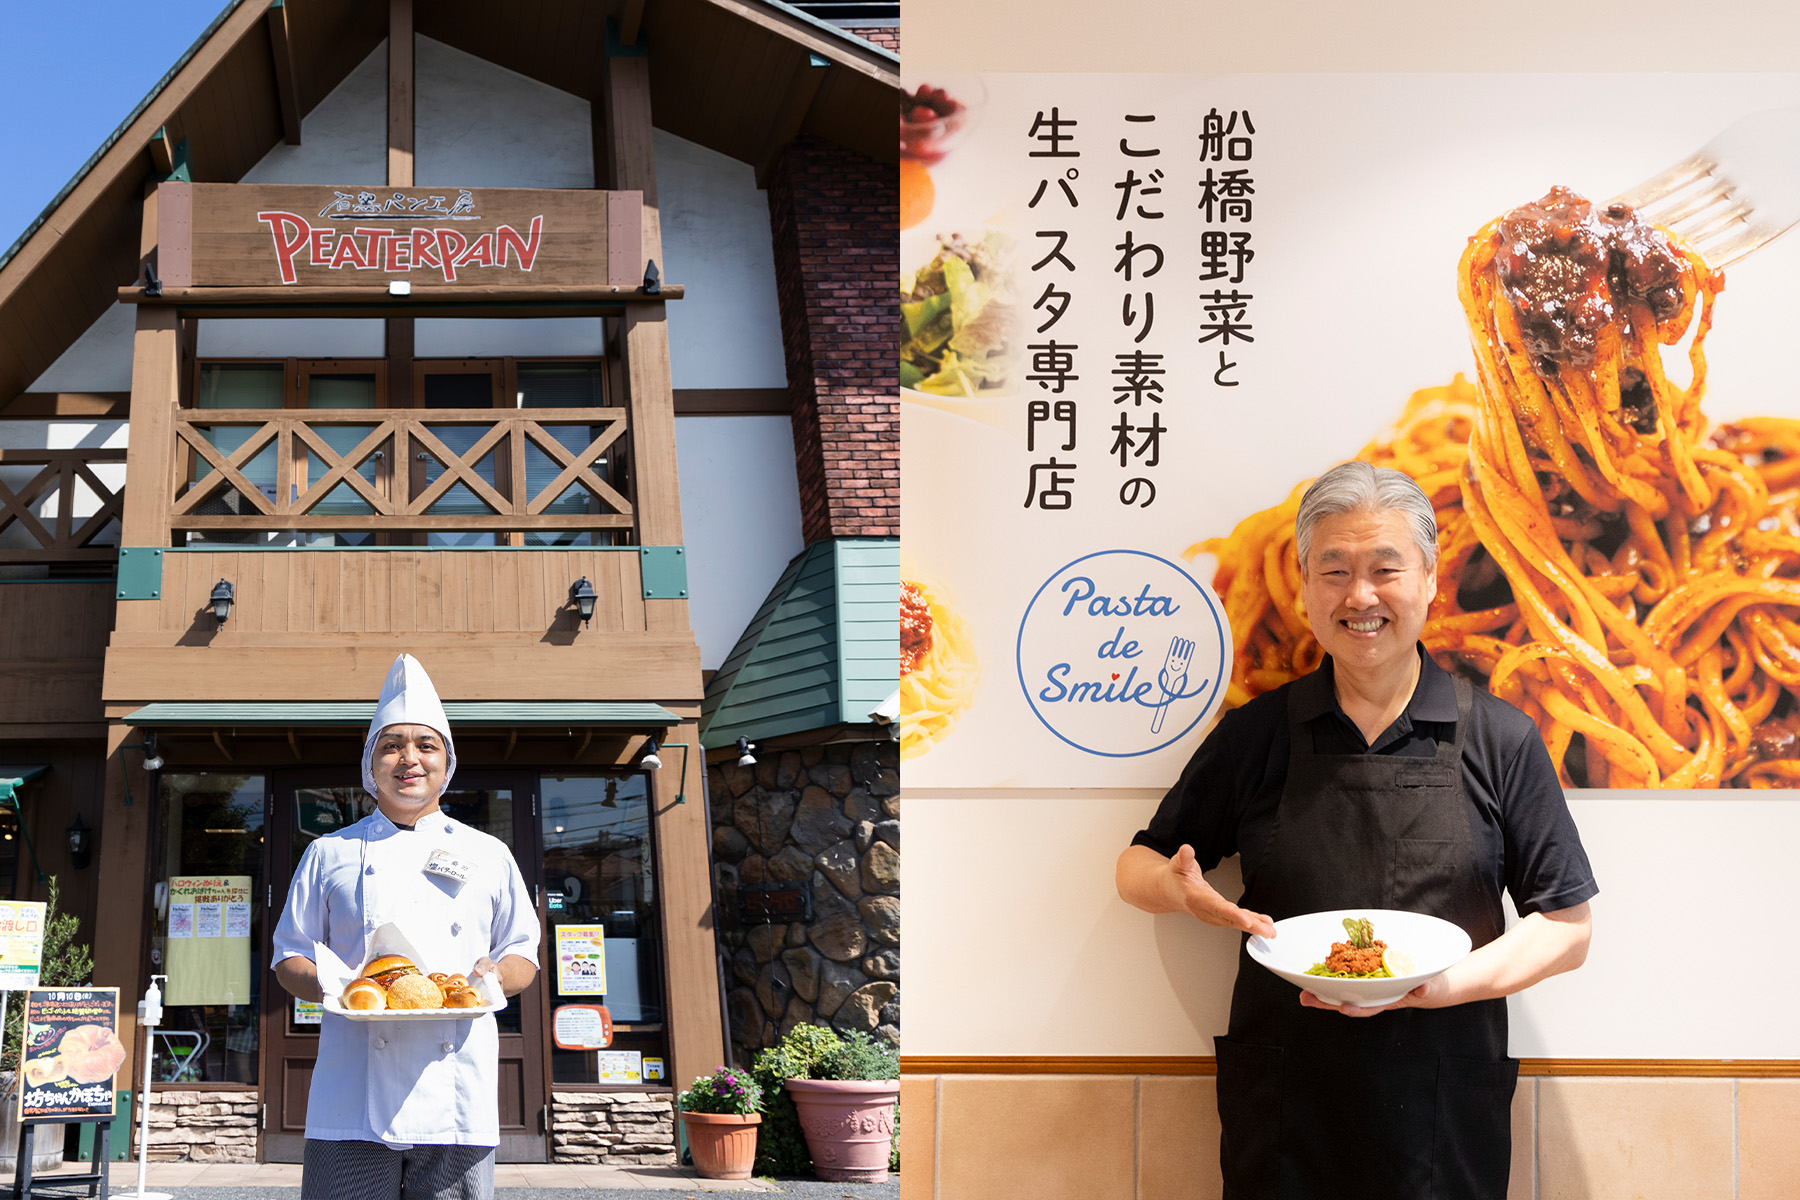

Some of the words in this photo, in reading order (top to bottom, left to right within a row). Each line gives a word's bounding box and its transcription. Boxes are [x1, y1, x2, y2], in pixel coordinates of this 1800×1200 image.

[257, 211, 544, 285] PEATERPAN
[1198, 107, 1256, 387] 船橋野菜と
[1023, 106, 1080, 510] 生パスタ専門店
[1110, 114, 1167, 509] こだわり素材の
[1061, 576, 1180, 617] Pasta
[1097, 626, 1143, 659] de
[1039, 662, 1189, 708] Smile
[24, 1084, 112, 1107] 坊ちゃんかぼちゃ
